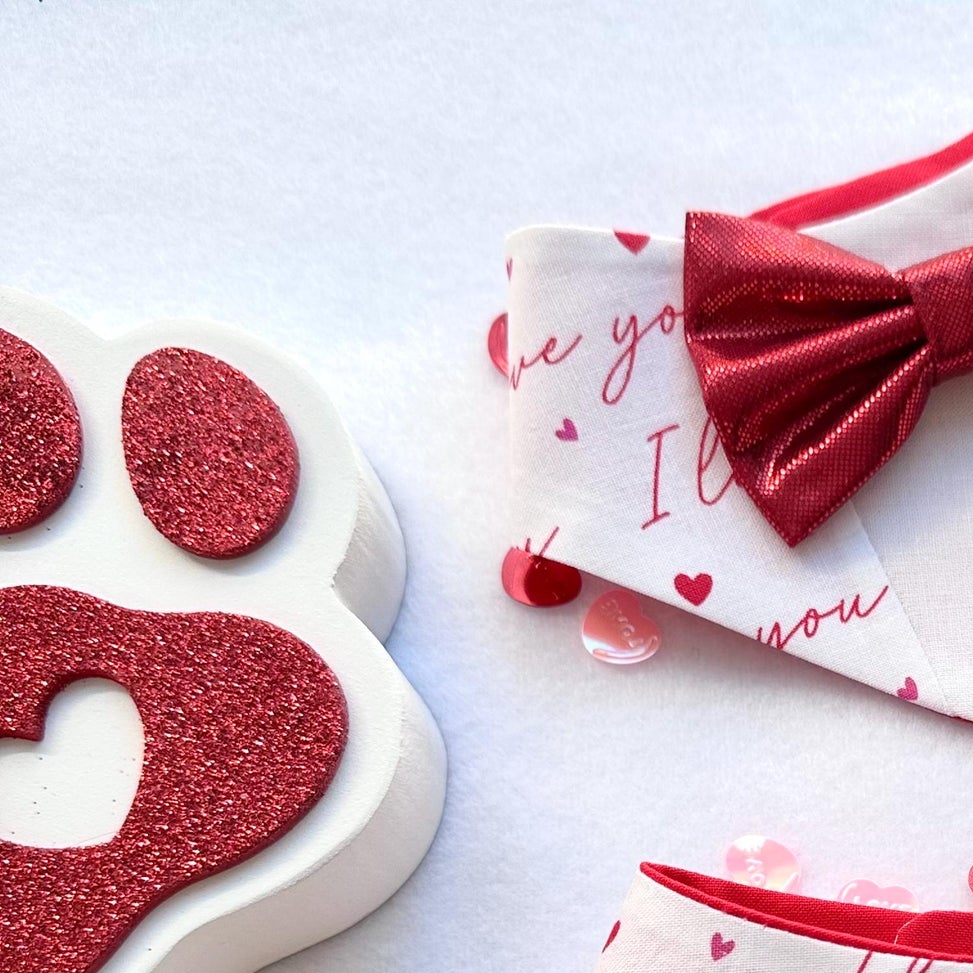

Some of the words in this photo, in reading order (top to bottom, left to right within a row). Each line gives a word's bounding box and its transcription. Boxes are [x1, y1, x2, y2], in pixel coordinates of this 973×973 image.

[510, 334, 583, 391] ve
[601, 303, 686, 406] yo
[641, 423, 681, 531] I
